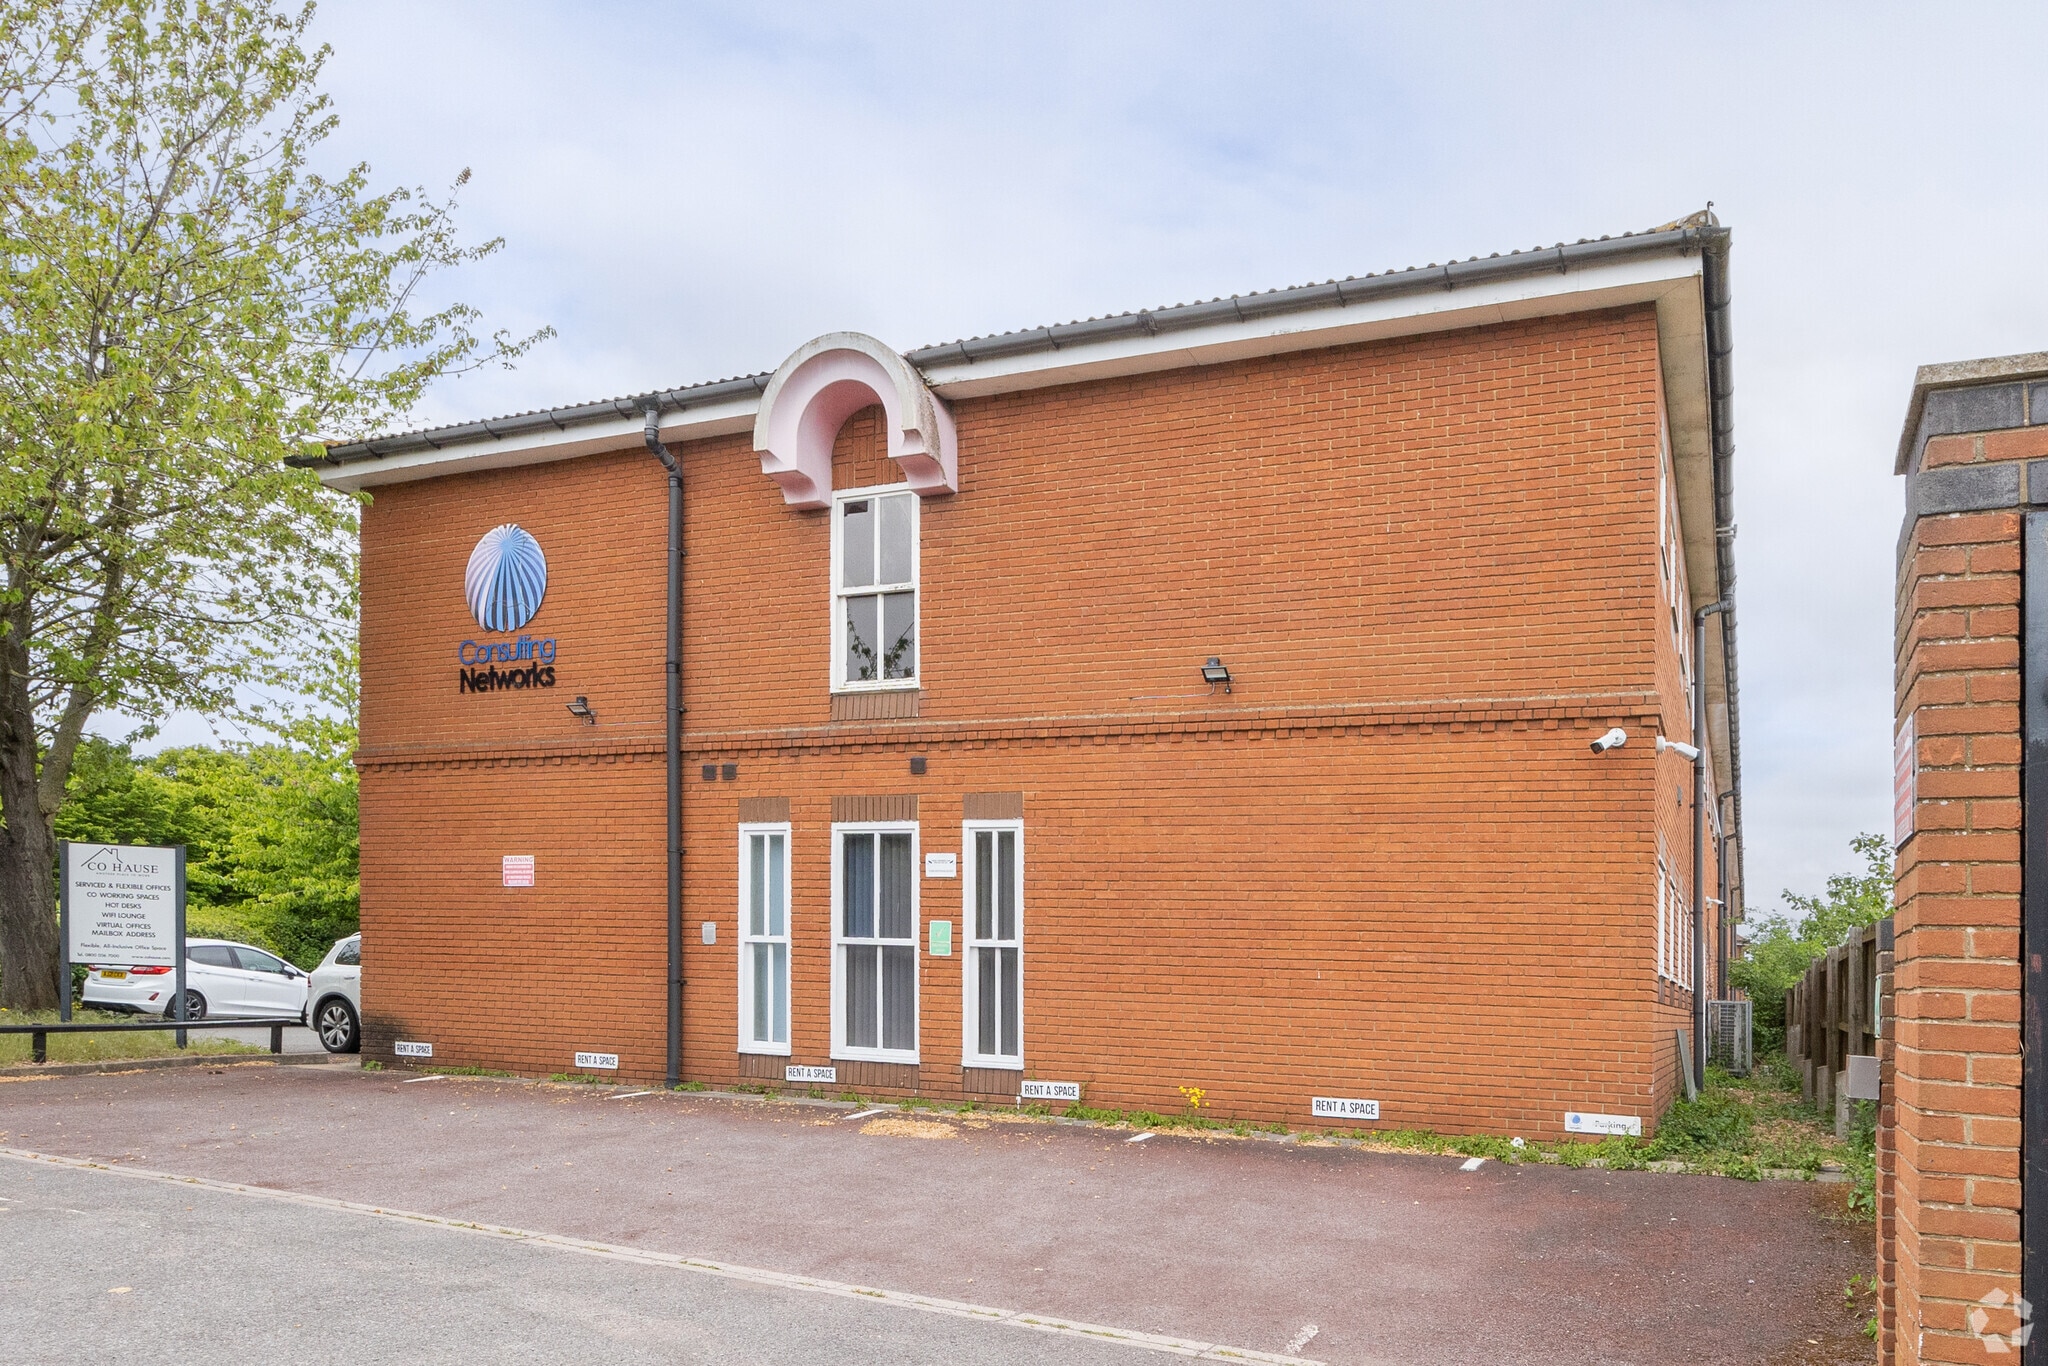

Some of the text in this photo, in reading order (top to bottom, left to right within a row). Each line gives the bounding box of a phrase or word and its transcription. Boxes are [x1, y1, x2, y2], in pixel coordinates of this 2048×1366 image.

[460, 662, 556, 694] Networks
[87, 862, 159, 874] CO HAUSE
[396, 1044, 430, 1054] RENT A SPACE
[578, 1054, 616, 1066] RENT A SPACE
[788, 1068, 833, 1079] RENT A SPACE
[1024, 1085, 1076, 1097] RENT A SPACE
[1315, 1100, 1376, 1115] RENT A SPACE
